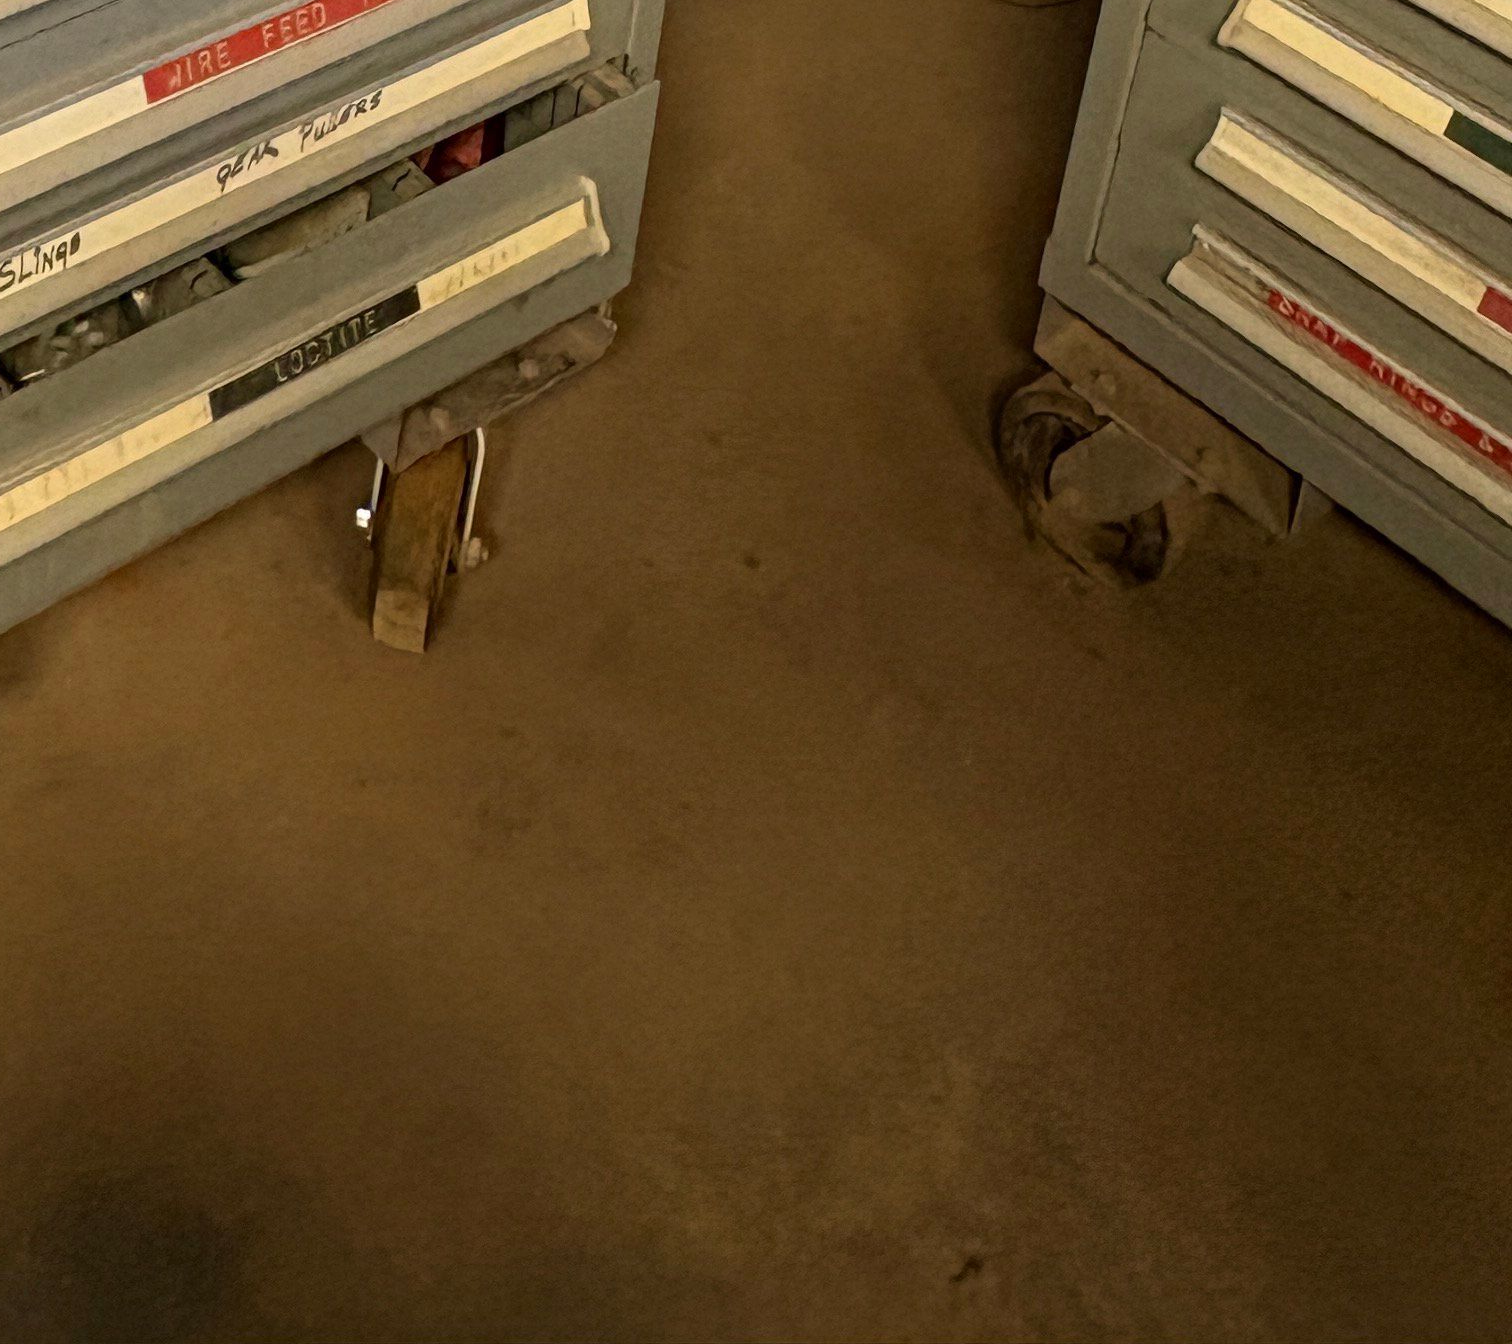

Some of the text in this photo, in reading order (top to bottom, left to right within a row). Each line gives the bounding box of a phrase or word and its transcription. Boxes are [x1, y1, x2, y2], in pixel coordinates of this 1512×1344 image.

[167, 41, 232, 91] WIRE
[261, 2, 328, 48] FEED
[274, 309, 379, 383] LOCTITE
